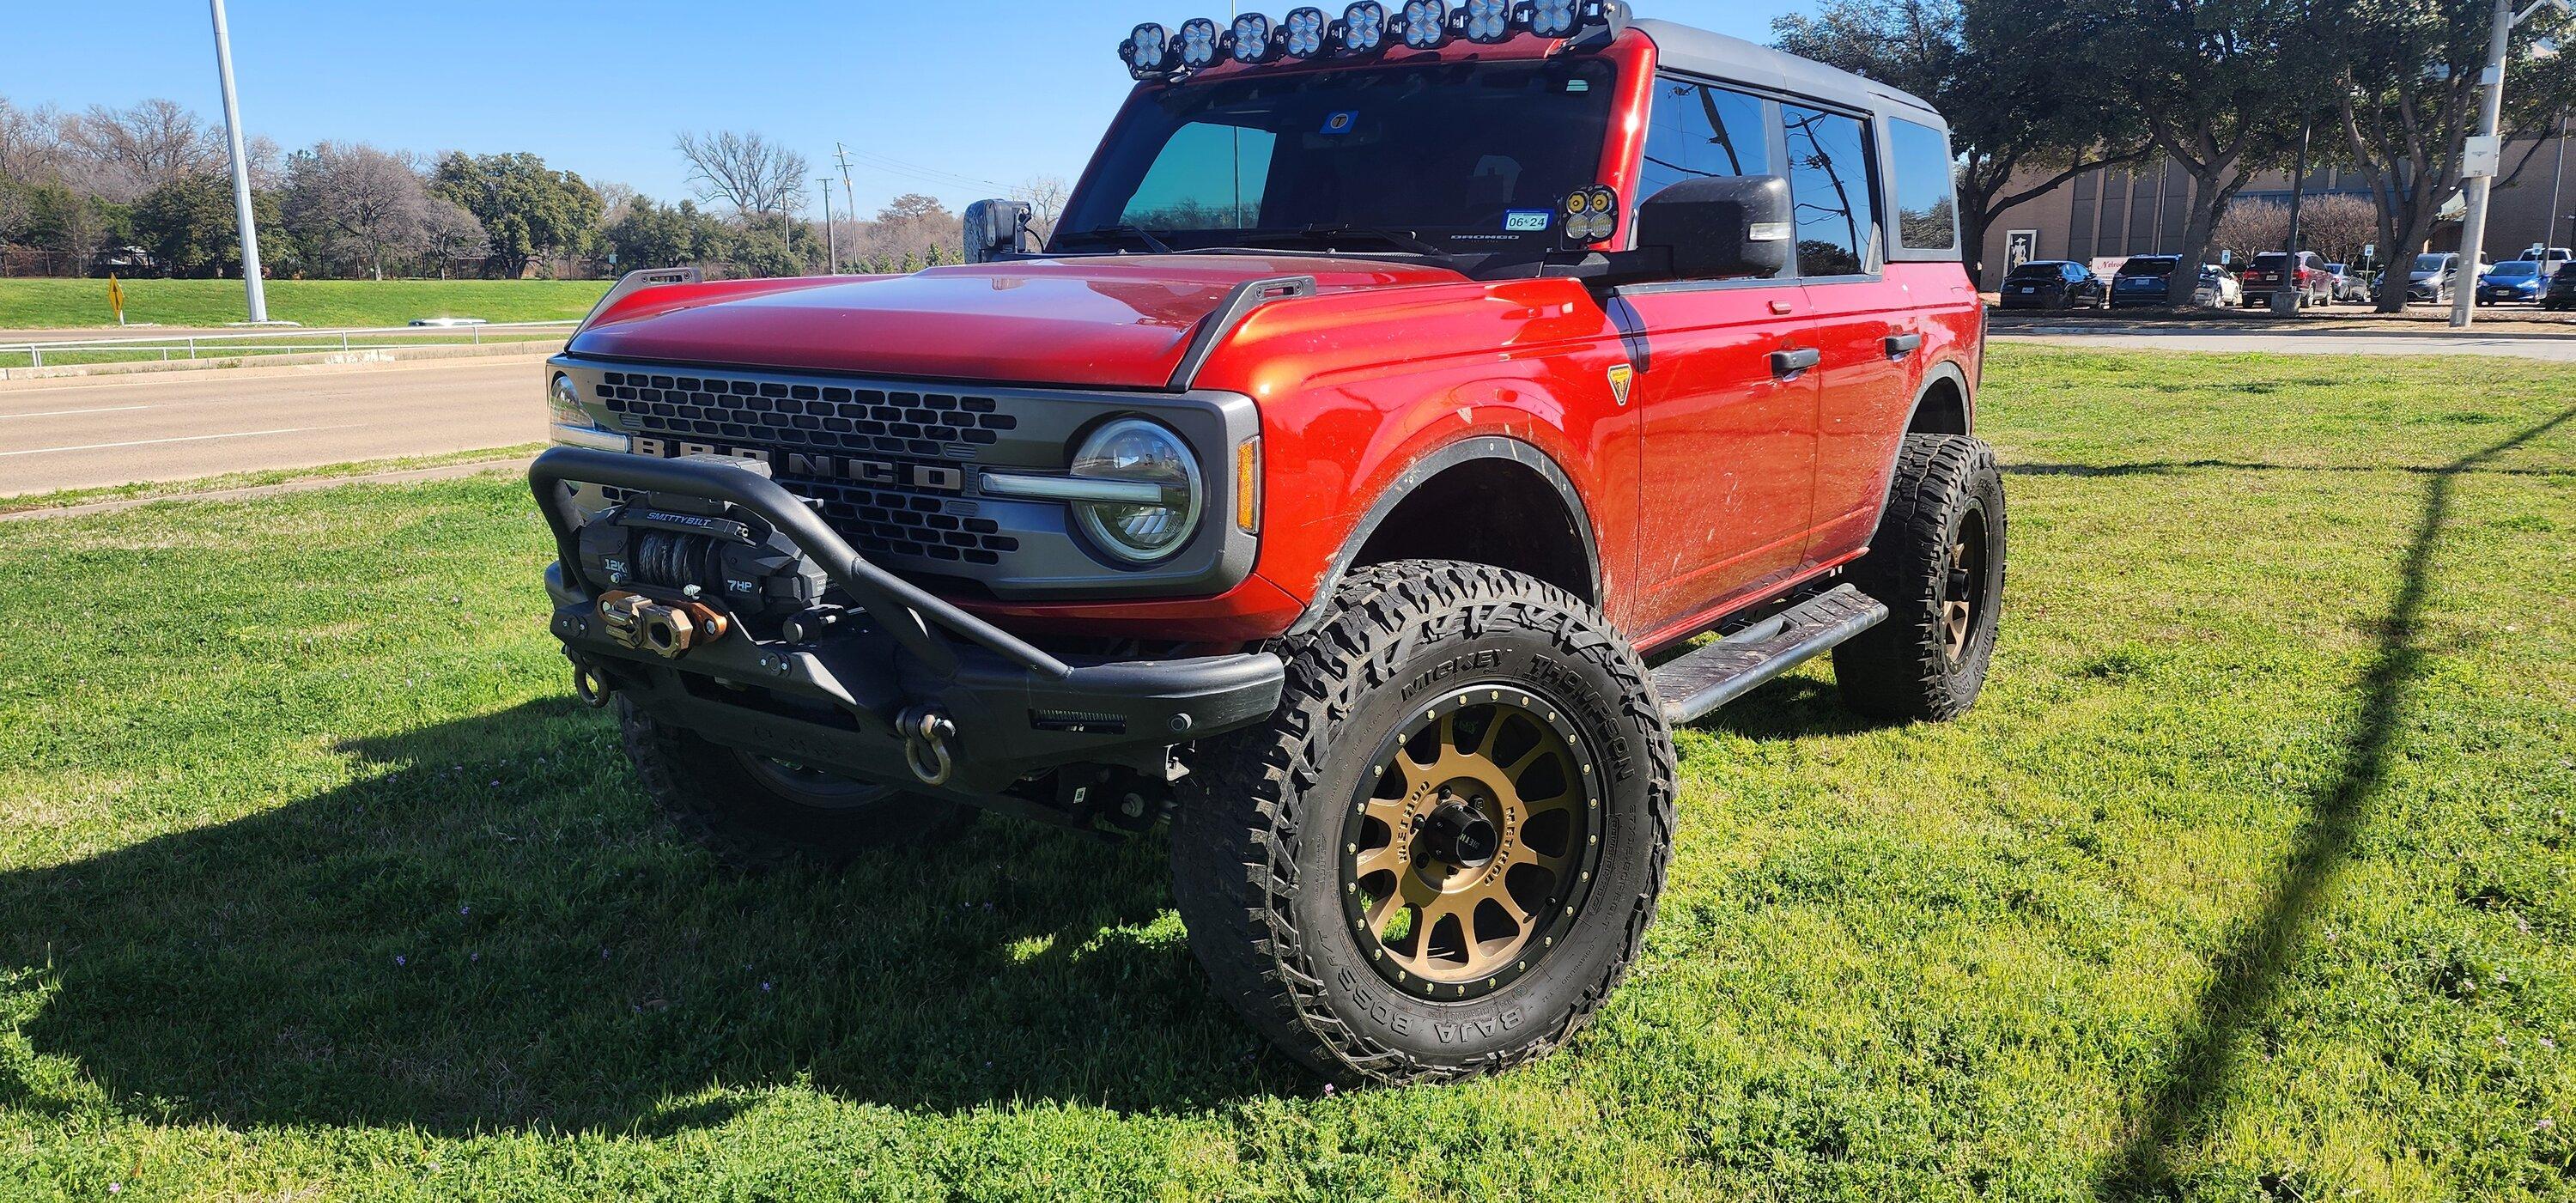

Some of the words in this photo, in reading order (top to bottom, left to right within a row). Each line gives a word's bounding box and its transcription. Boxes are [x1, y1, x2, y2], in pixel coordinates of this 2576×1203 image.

[1509, 217, 1524, 227] 06
[1529, 217, 1545, 227] 24
[647, 512, 712, 526] SMITTYBILT
[727, 579, 752, 592] 7HP
[1400, 648, 1513, 702] MICKEY
[1528, 653, 1635, 783] THOMPSON
[1397, 781, 1431, 865] METHOD
[1484, 805, 1516, 887] METHOD
[1337, 966, 1414, 1037] BOSS
[1434, 1006, 1525, 1044] BAJA
